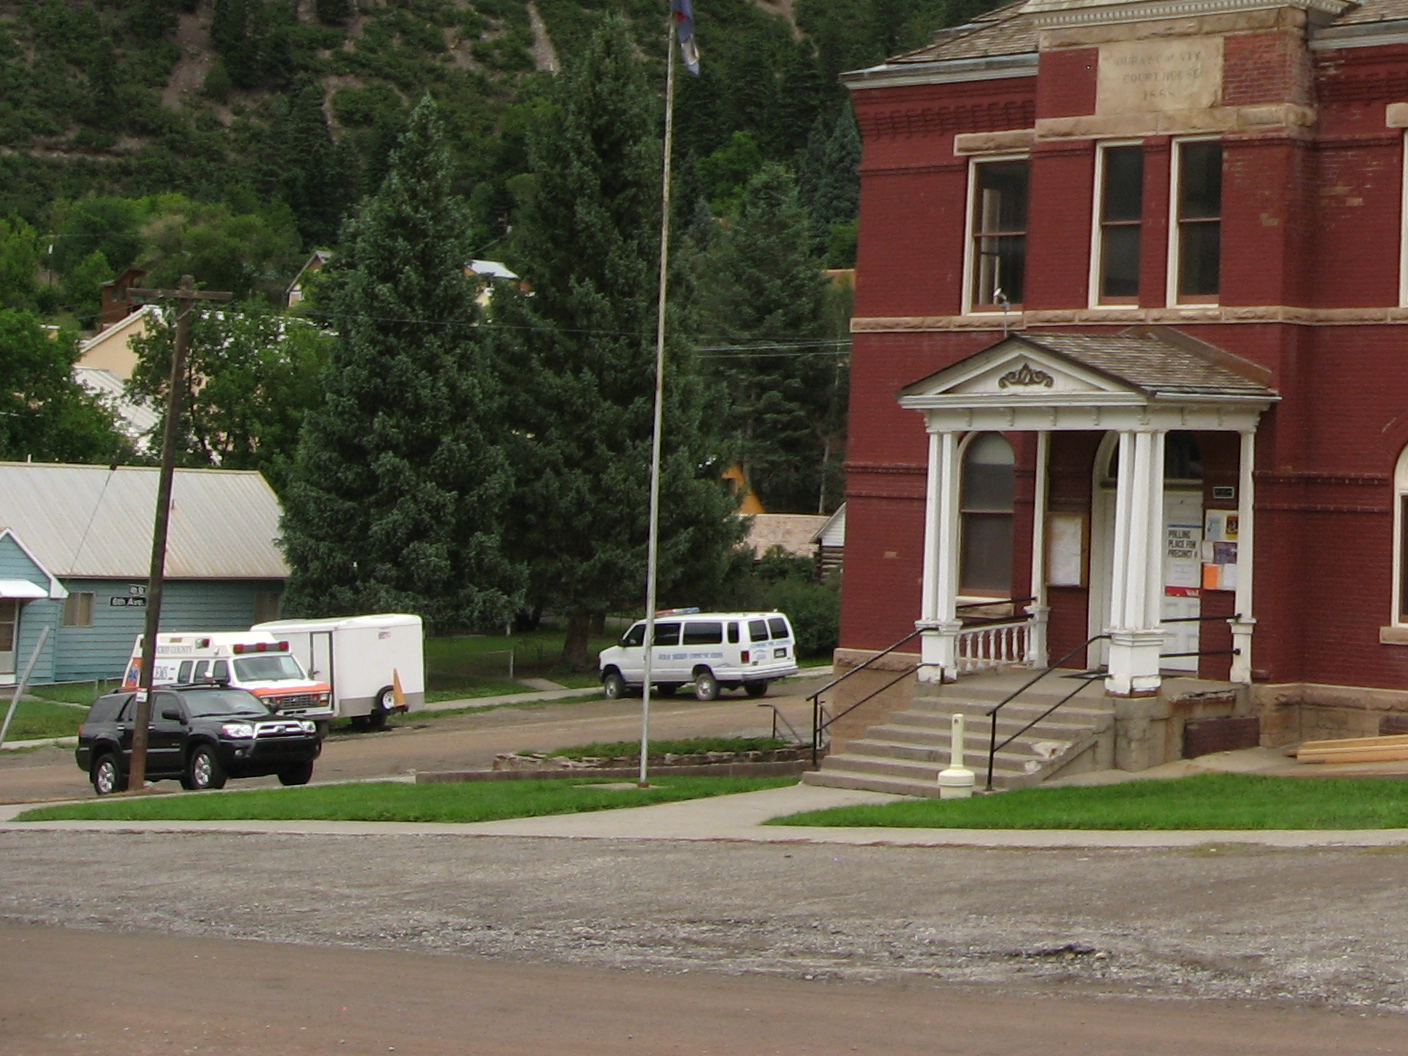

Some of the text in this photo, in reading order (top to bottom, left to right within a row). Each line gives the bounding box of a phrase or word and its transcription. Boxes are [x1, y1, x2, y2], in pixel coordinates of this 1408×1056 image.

[1168, 529, 1191, 539] POLLING
[1168, 539, 1197, 549] PLACE FOR
